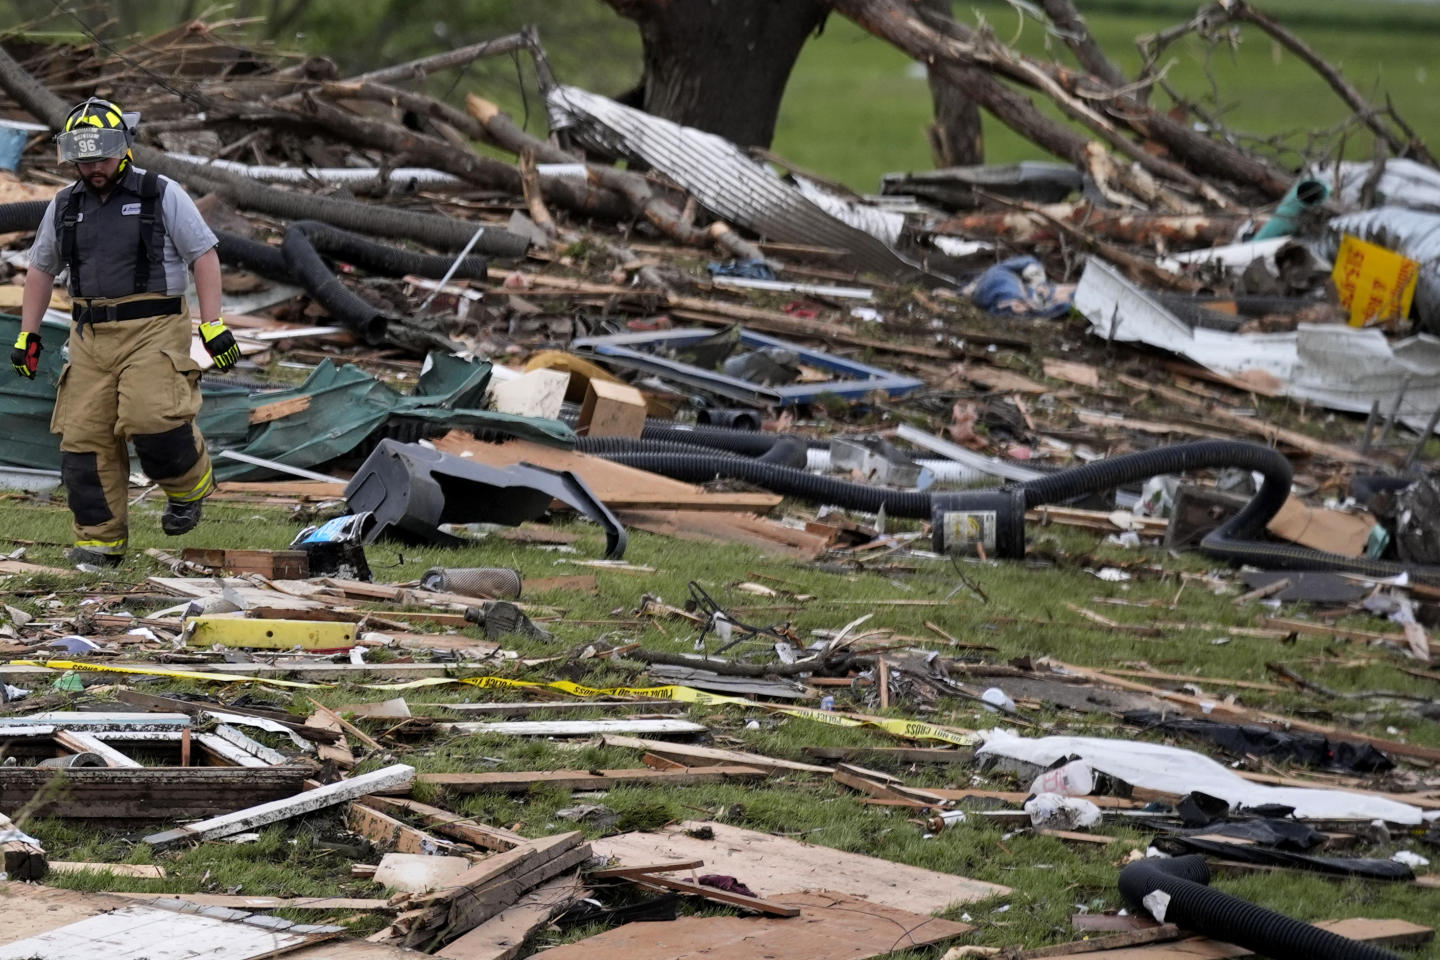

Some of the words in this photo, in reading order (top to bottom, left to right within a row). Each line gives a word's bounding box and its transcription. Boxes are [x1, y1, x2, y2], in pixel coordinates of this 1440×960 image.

[78, 139, 97, 153] 96
[905, 723, 931, 735] CROSS
[933, 728, 949, 738] NOT
